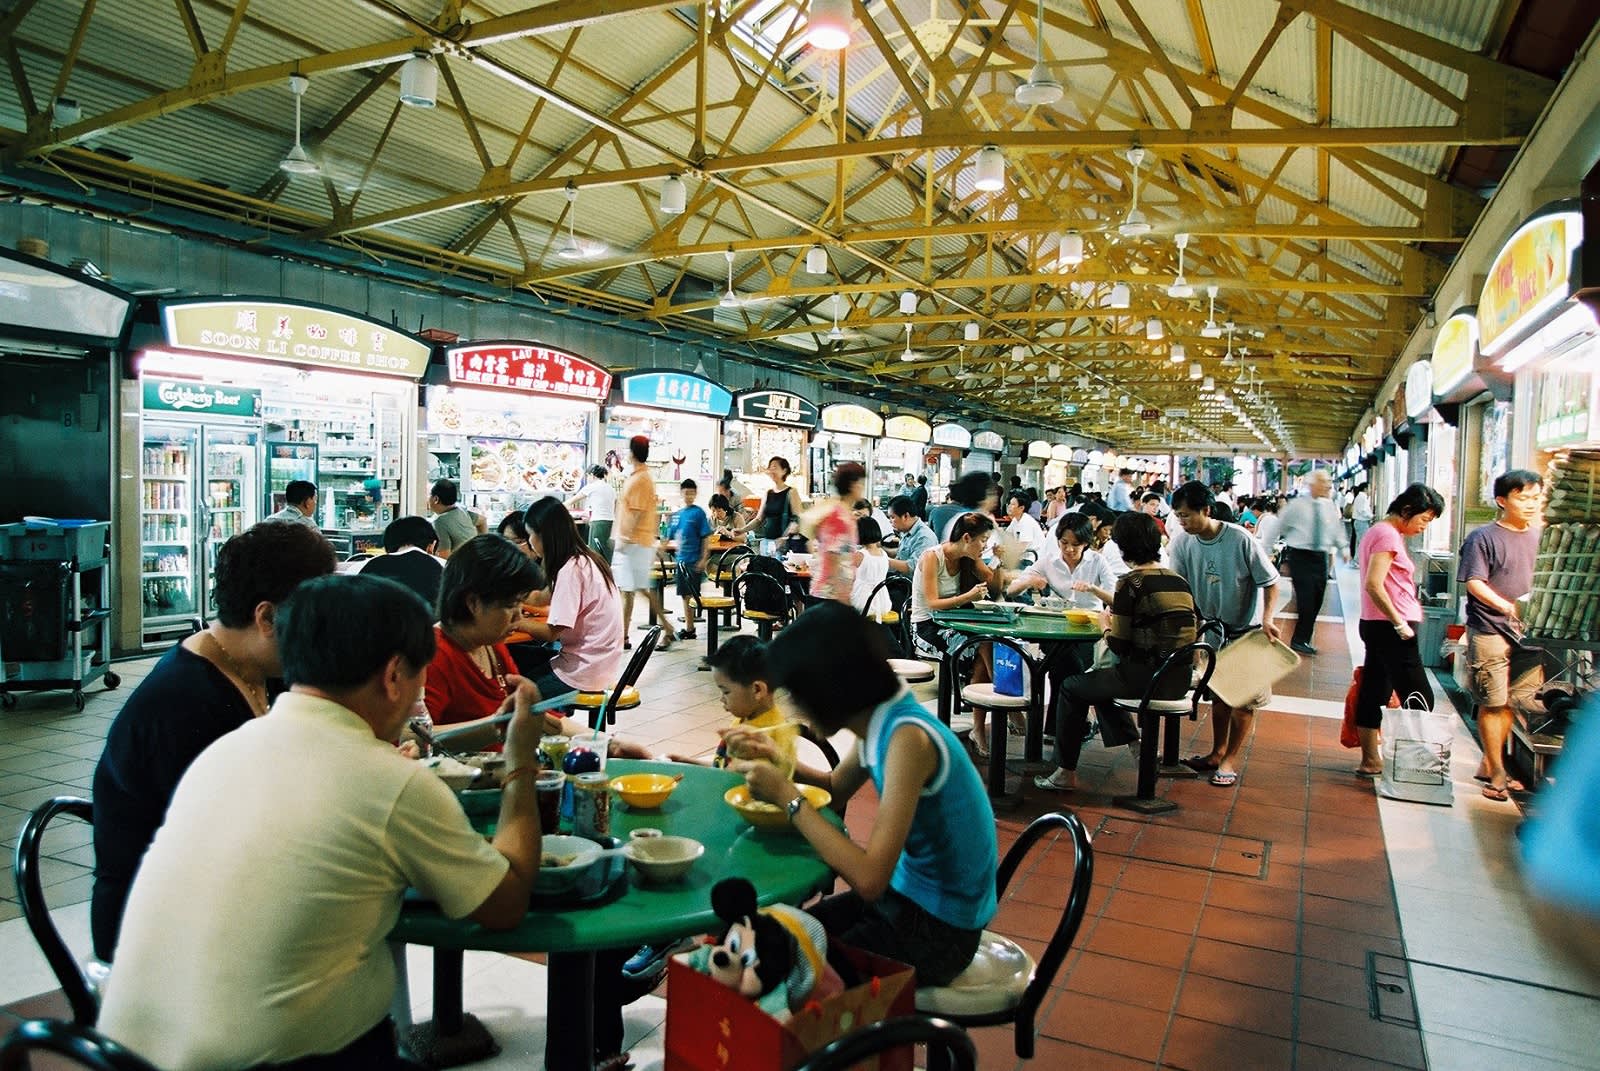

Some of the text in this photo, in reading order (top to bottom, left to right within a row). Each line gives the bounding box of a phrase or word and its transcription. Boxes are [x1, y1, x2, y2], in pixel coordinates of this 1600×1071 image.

[201, 329, 410, 369] SOON LI COFFEE SHOP
[512, 349, 532, 361] LAU
[537, 349, 549, 361] PA
[158, 382, 215, 409] Carlsberg
[215, 389, 241, 405] Beer
